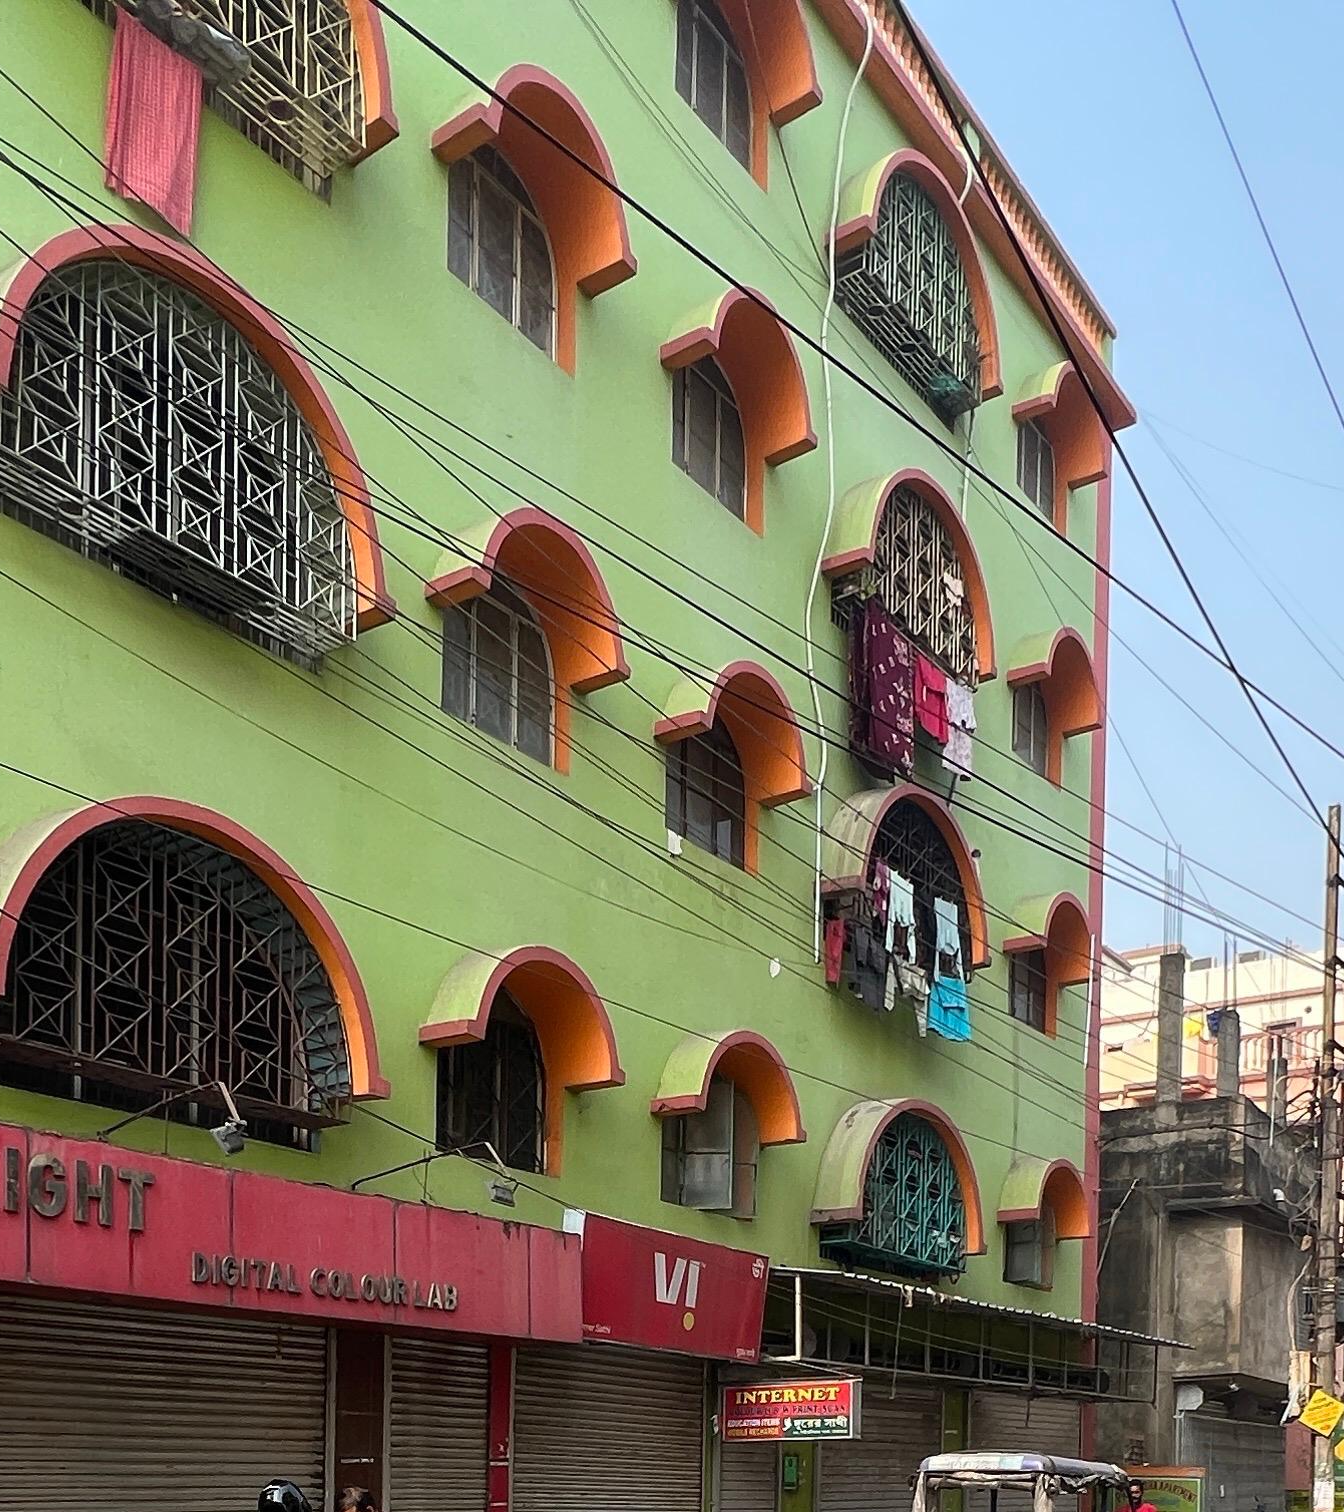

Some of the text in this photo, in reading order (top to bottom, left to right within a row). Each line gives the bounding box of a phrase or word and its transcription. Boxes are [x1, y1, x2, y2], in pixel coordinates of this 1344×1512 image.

[192, 1252, 459, 1311] DIGITAL COLOUR LAB
[735, 1387, 840, 1405] INTERNET
